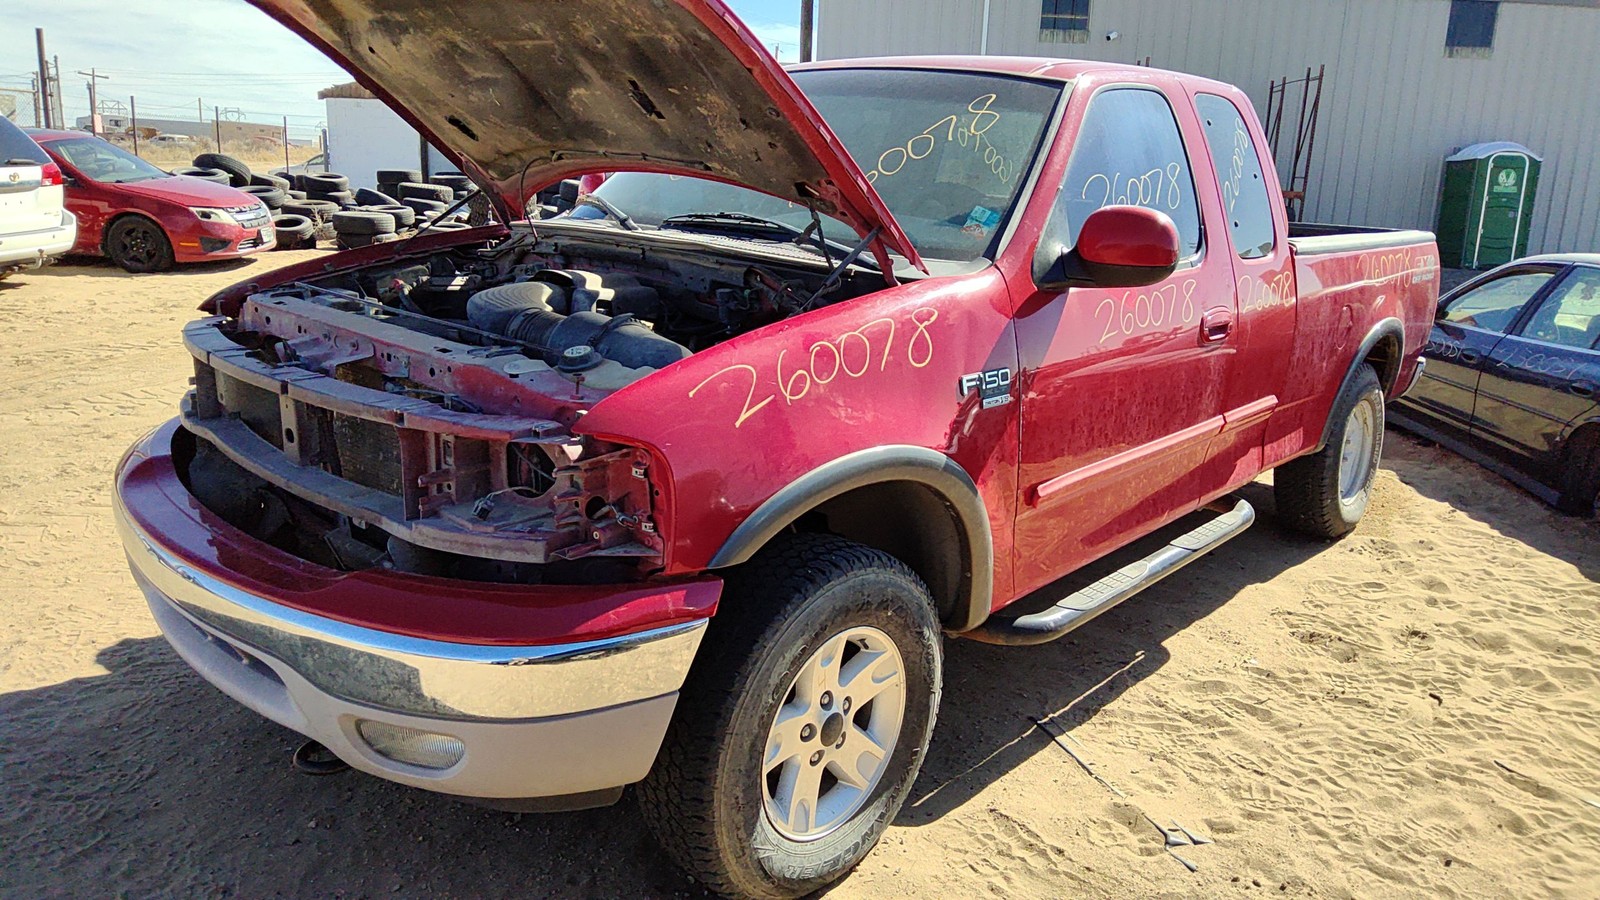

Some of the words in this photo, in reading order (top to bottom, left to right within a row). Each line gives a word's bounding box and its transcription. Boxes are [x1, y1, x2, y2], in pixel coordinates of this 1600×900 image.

[1081, 162, 1181, 210] 260078
[1223, 117, 1248, 214] 260078
[1237, 271, 1293, 314] 260078
[1356, 246, 1411, 288] 260078
[1094, 278, 1197, 344] 260078
[688, 307, 938, 428] 260078
